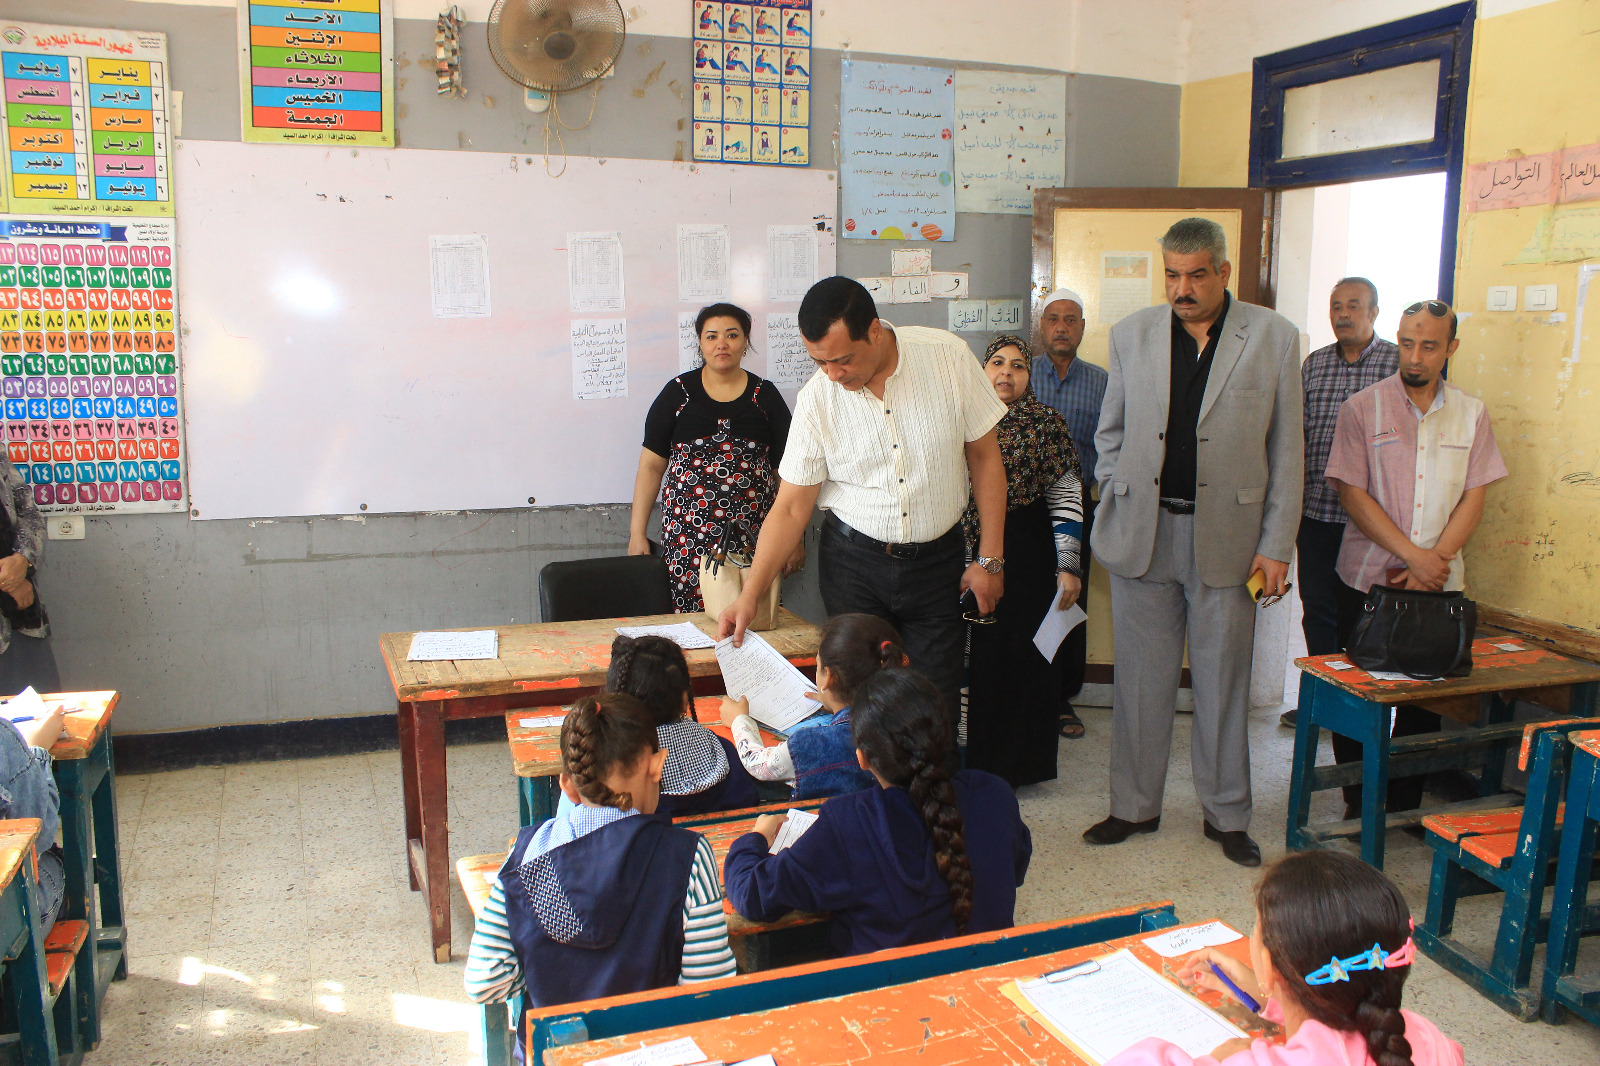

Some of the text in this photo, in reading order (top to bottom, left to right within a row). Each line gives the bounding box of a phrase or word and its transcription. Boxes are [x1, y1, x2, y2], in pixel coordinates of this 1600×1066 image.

[73, 32, 106, 47] السنة
[285, 50, 342, 66] الثلاثاء
[18, 61, 60, 76] يوليو
[99, 68, 139, 81] يناير
[100, 91, 141, 104] فبراير
[285, 92, 342, 106] الخميس
[23, 111, 62, 124] سبتمبر
[105, 114, 142, 126] مارس
[286, 110, 344, 128] الجمعة
[24, 156, 62, 168] نوفمبر
[105, 162, 144, 174] مايو
[28, 182, 68, 194] ديسمبر
[109, 182, 145, 196] يونيو
[19, 247, 169, 263] ١١٤ ١١٥ ١١٦ ١١٧ ١١٨ ١١٩ ١٢٠
[20, 268, 170, 284] ١٠٤ ١٠٥ ١٠٦ ١٠٧ ١٠٨ ١٠٩ ١١٠
[902, 281, 926, 295] الفاء
[944, 278, 960, 292] و
[22, 292, 40, 306] ٩٤
[44, 292, 62, 306] ٩٥
[68, 292, 85, 306] ٩٦
[90, 293, 107, 307] ٩٧
[112, 292, 129, 306] ٩٨
[133, 292, 150, 306] ٩٩
[155, 293, 172, 307] ١٠٠
[2, 313, 171, 328] ٨٣ ٨٤ ٨٥ ٨٦ ٨٧ ٨٨ ٨٩ ٩٠
[2, 335, 172, 349] ٧٣ ٧٤ ٧٥ ٧٦ ٧٧ ٧٨ ٧٩ ٨٠
[3, 359, 21, 373] ٦٣
[27, 357, 43, 371] ٦٤
[70, 358, 88, 372] ٦٦
[93, 358, 109, 372] ٦٧
[114, 357, 130, 371] ٦٨
[136, 357, 151, 371] ٦٩
[6, 379, 175, 395] ٥٣ ٥٤ ٥٥ ٥٦ ٥٧ ٥٨ ٥٩ ٦٠
[8, 399, 175, 416] ٤٣ ٤٤ ٤٥ ٤٦ ٤٧ ٤٨ ٤٩ ٥٠
[9, 421, 175, 438] ٣٣ ٣٤ ٣٥ ٣٦ ٣٧ ٣٨ ٣٩ ٤٠
[10, 446, 27, 458] ٢٣
[33, 444, 49, 458] ٢٤
[55, 445, 71, 457] ٢٥
[76, 444, 93, 458] ٢٦
[98, 444, 113, 457] ٢٧
[120, 443, 136, 456] ٢٨
[140, 442, 156, 455] ٢٩
[35, 463, 178, 481] ١٤ ١٥ ١٦ ١٧ ١٨ ١٩ ٢٠
[41, 486, 48, 502] ٤
[62, 487, 69, 500] ٥
[82, 486, 93, 500] ٦
[104, 485, 114, 500] ٧
[125, 483, 135, 498] ٨
[163, 484, 178, 497] ١٠
